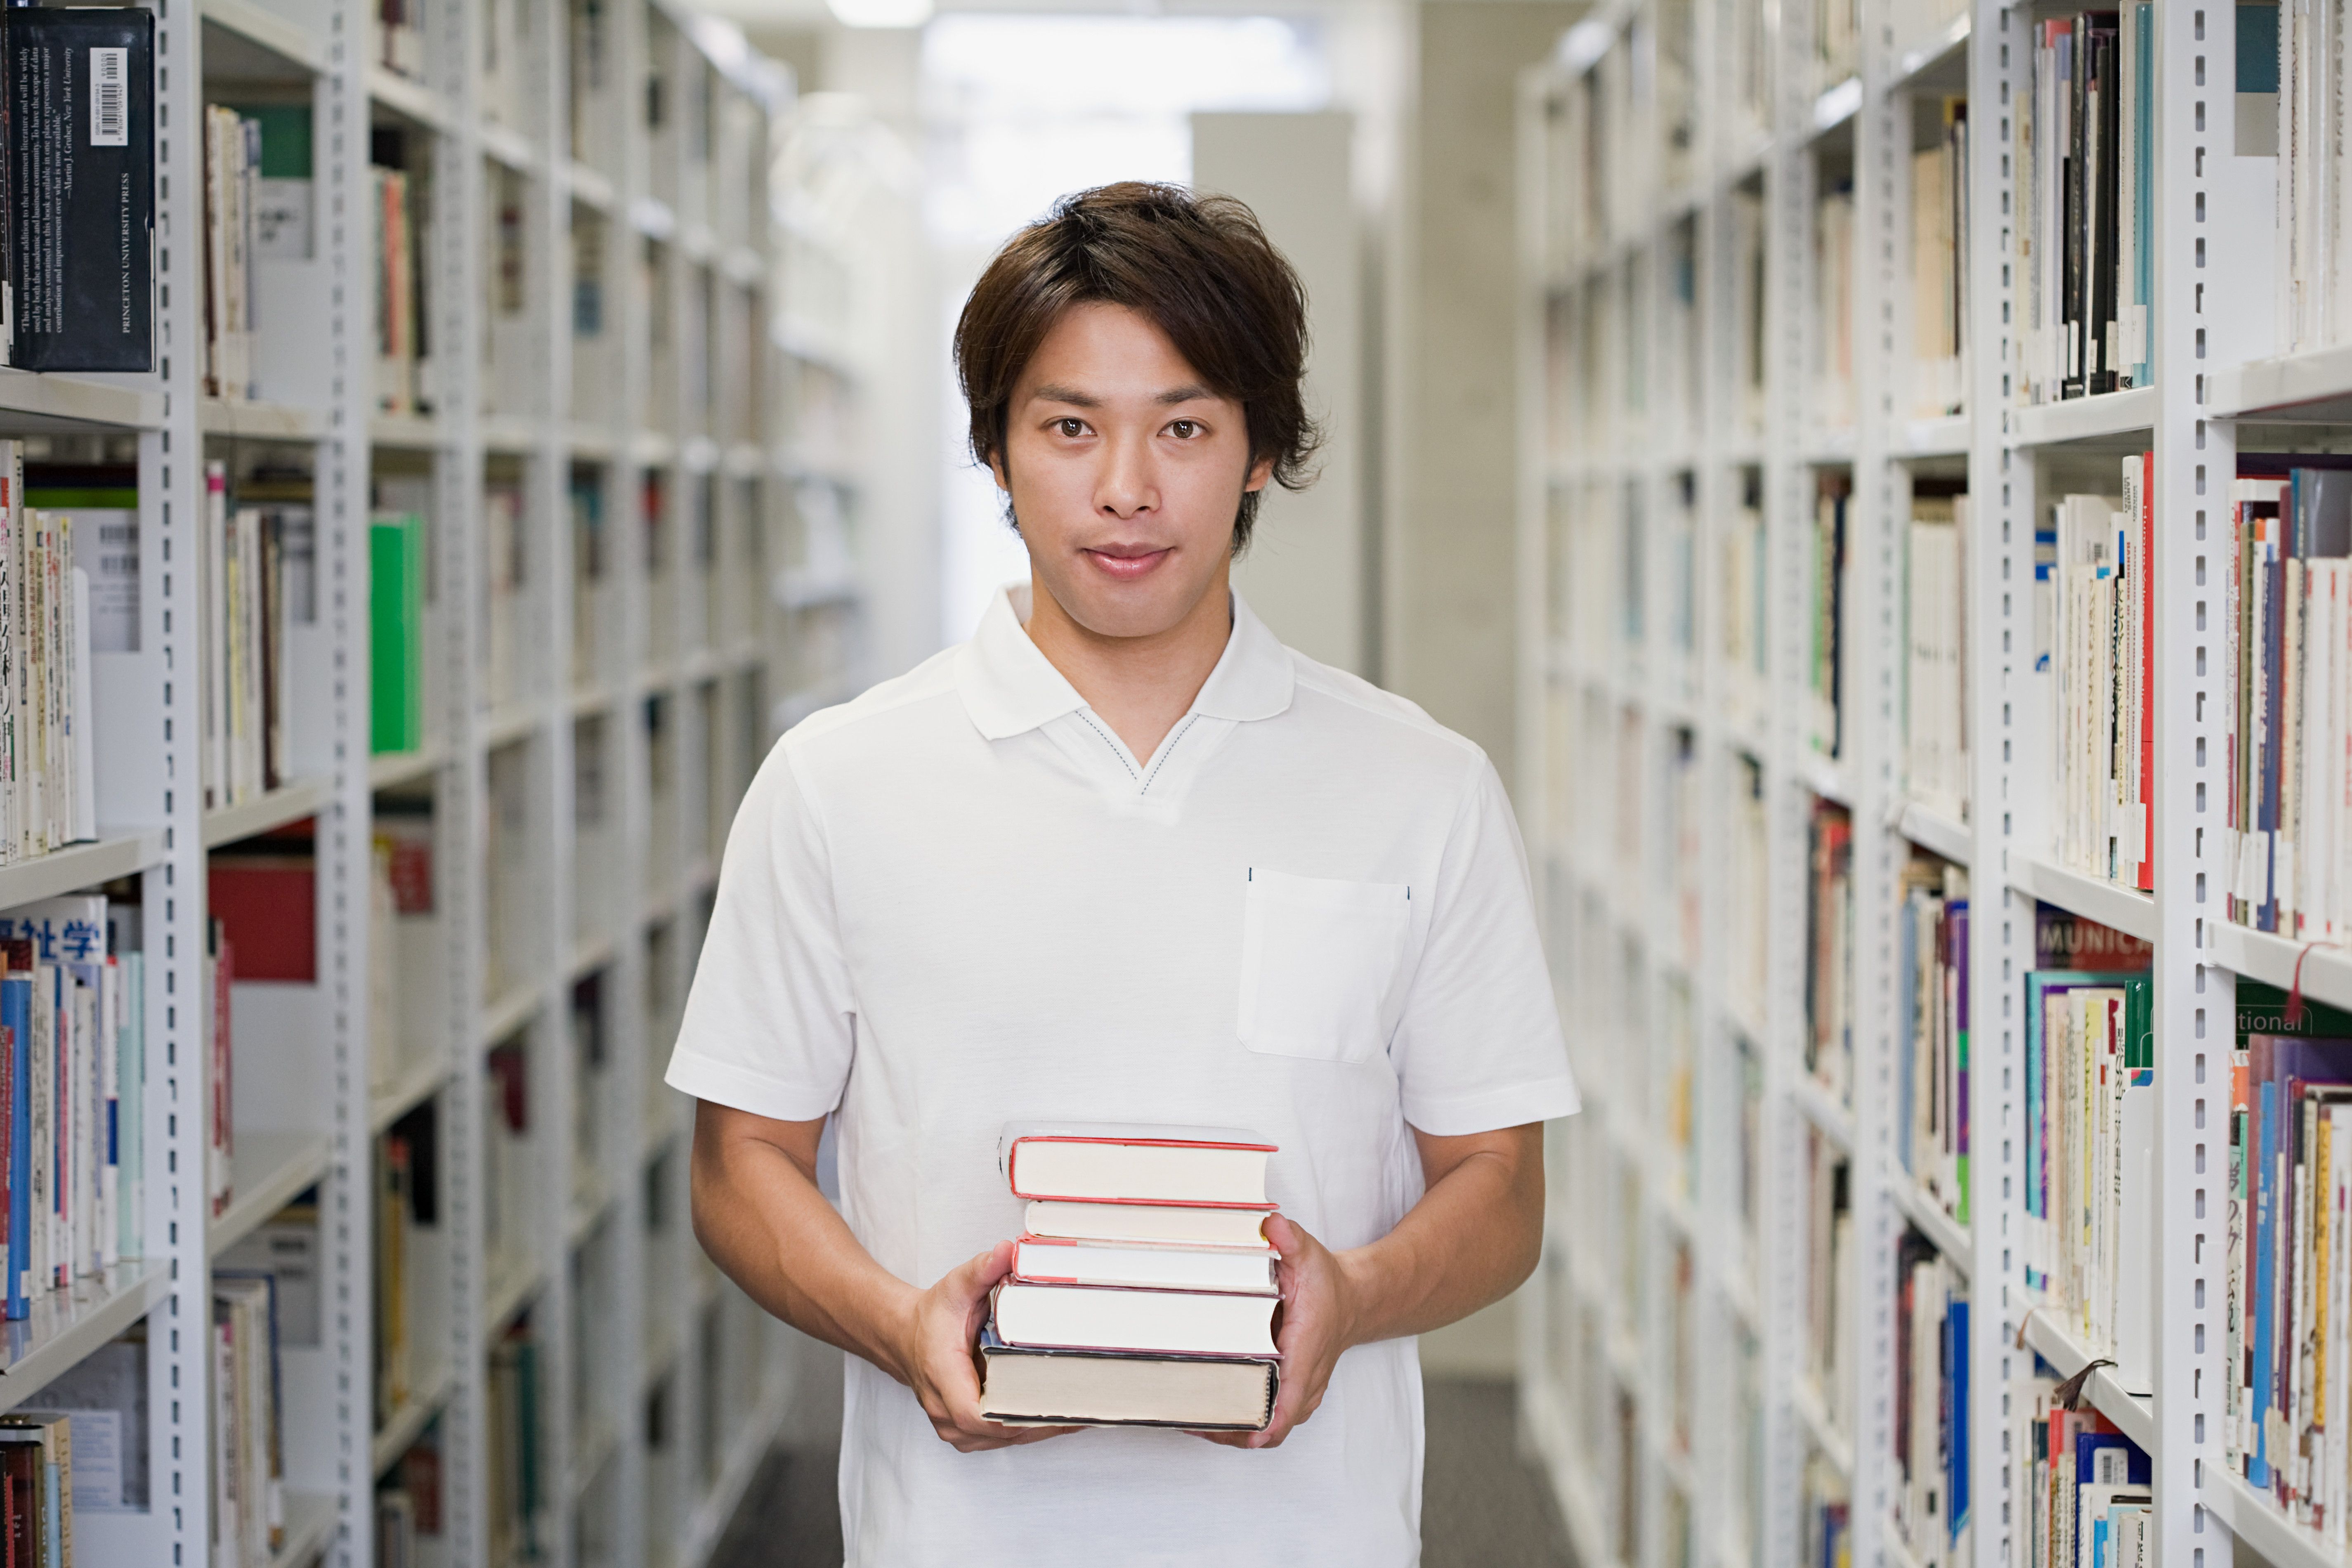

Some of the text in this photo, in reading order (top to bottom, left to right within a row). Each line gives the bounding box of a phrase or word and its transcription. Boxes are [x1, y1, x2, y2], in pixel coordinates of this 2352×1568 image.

[21, 47, 31, 72] widely
[30, 47, 38, 63] data
[63, 45, 73, 85] University
[21, 73, 29, 83] be
[21, 84, 29, 99] will
[43, 78, 52, 117] represents
[64, 86, 72, 103] York
[21, 100, 29, 114] and
[31, 97, 39, 109] the
[31, 111, 39, 128] have
[64, 104, 72, 122] New
[21, 116, 29, 151] literature
[31, 129, 39, 138] To
[42, 119, 52, 139] place
[64, 123, 74, 154] Gruber,
[31, 141, 41, 186] community.
[64, 155, 74, 164] J.
[21, 152, 29, 194] investment
[42, 167, 50, 199] available
[53, 177, 61, 195] what
[21, 195, 29, 208] the
[31, 187, 39, 219] business
[42, 201, 50, 220] book
[22, 209, 29, 218] to
[21, 219, 29, 251] addition
[31, 220, 40, 235] and
[43, 222, 51, 236] this
[53, 216, 63, 267] improvement
[31, 236, 40, 270] academic
[21, 252, 31, 290] important
[43, 248, 51, 286] contained
[53, 269, 61, 283] and
[31, 271, 40, 284] the
[24, 292, 29, 302] an
[31, 285, 40, 303] both
[43, 287, 53, 317] analysis
[32, 305, 42, 314] by
[53, 285, 61, 333] contribution
[32, 315, 40, 333] used
[43, 319, 51, 333] and
[0, 918, 101, 960] 祉学
[2238, 1011, 2302, 1031] tional
